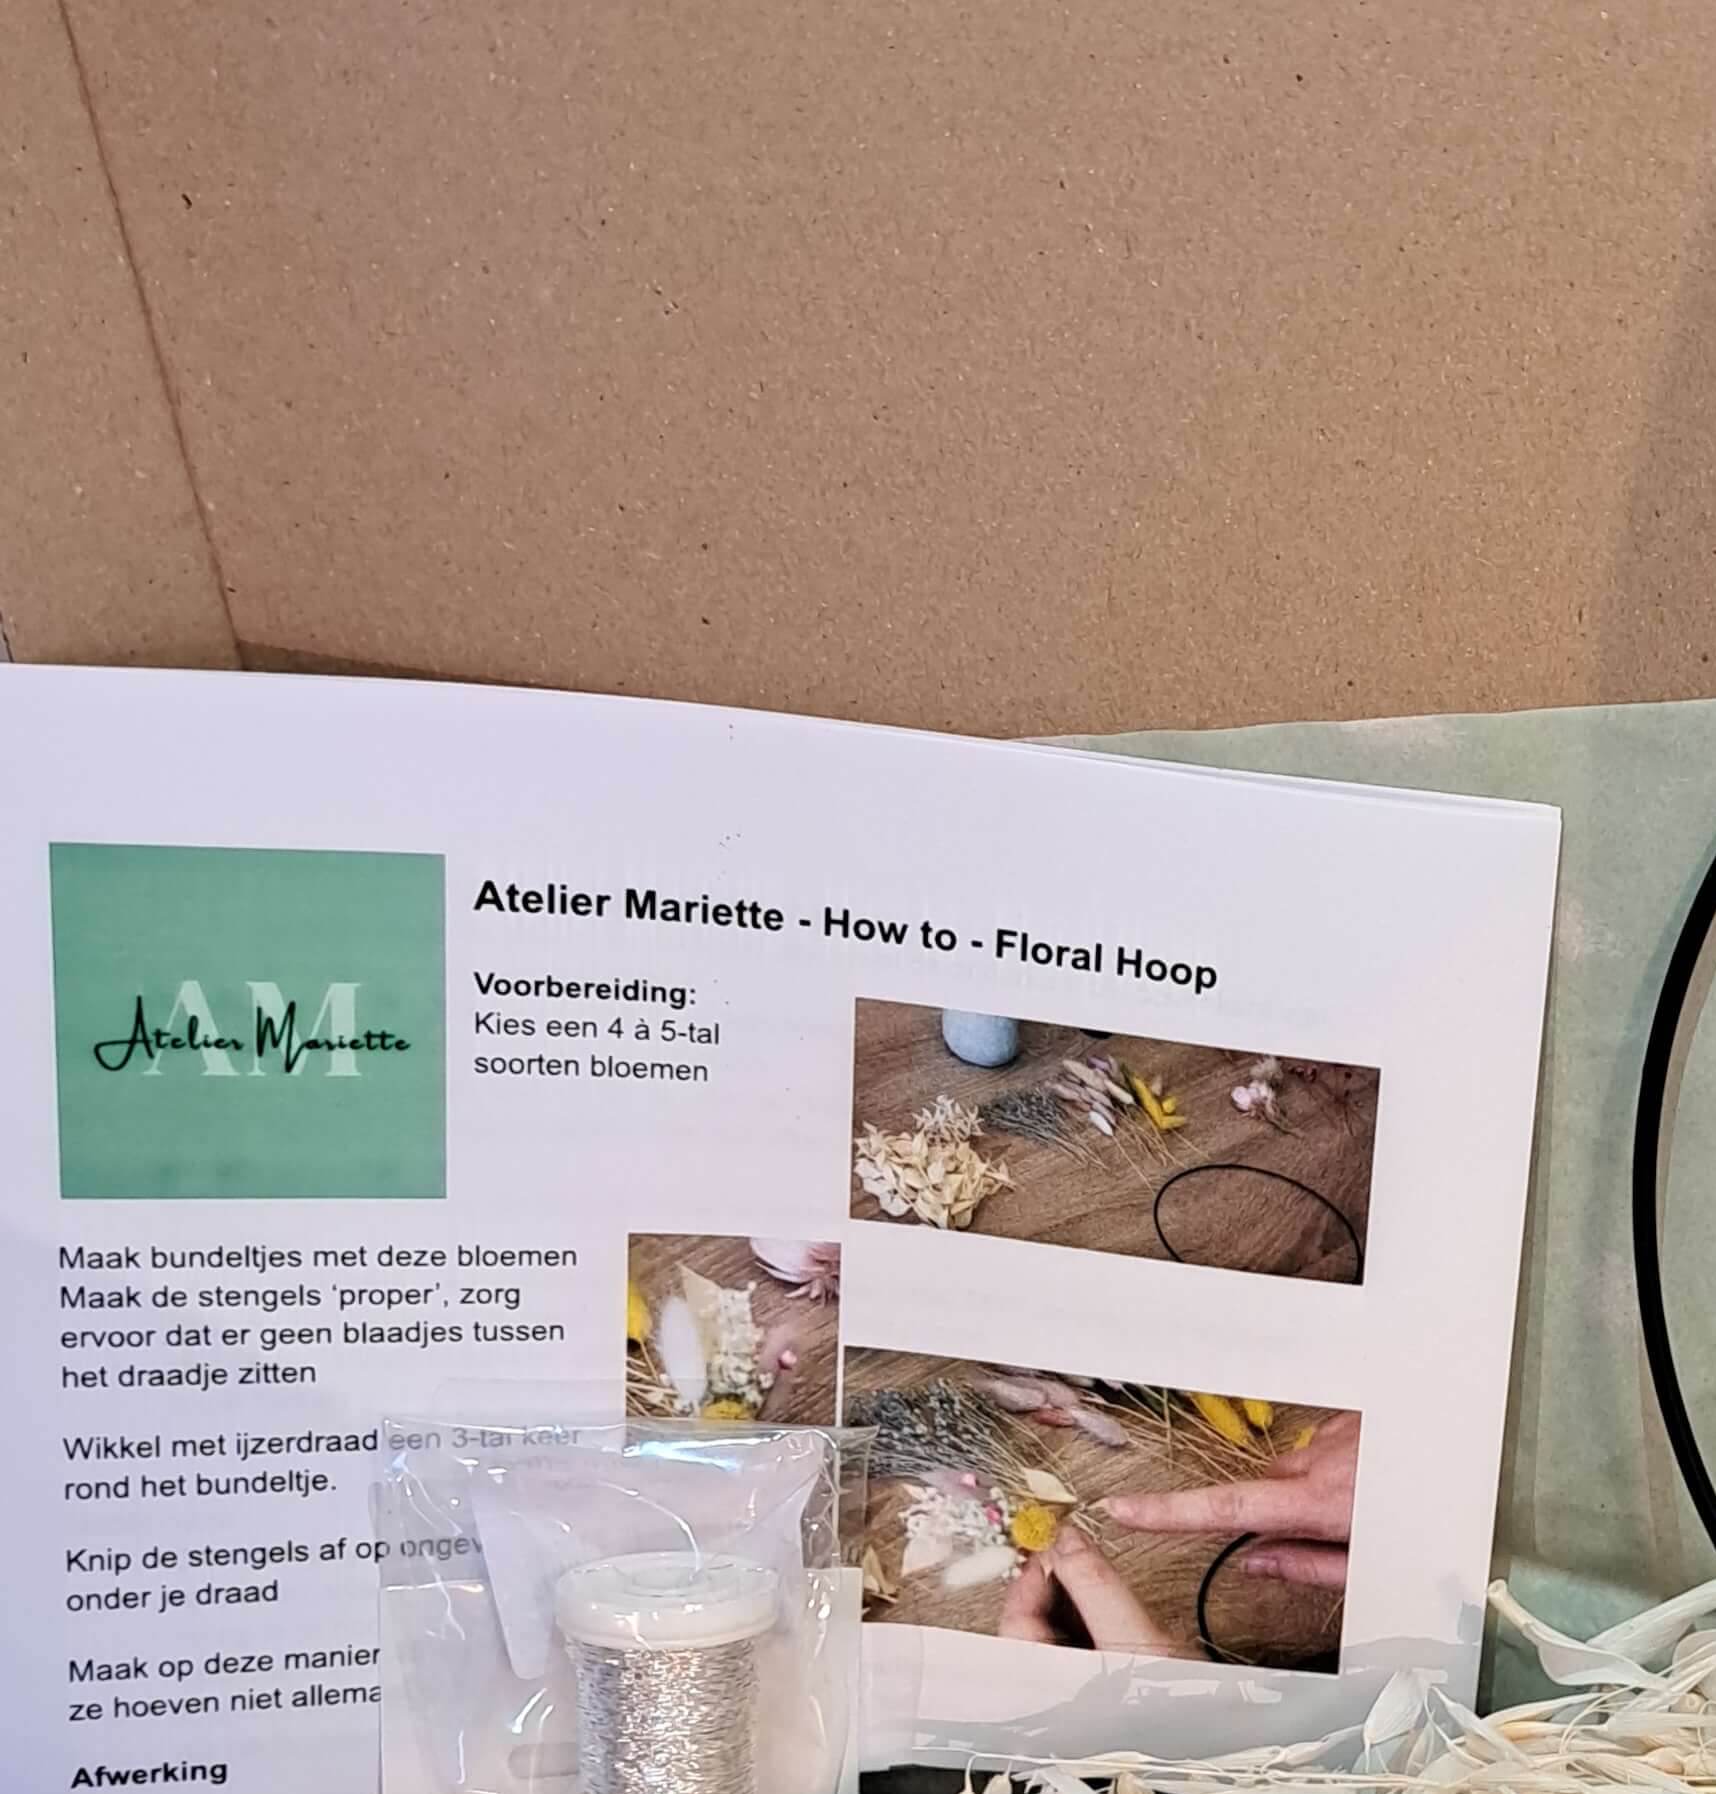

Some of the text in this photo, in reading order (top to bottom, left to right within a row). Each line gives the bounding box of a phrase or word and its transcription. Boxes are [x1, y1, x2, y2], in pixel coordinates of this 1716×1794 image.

[473, 880, 612, 917] Atelier
[625, 888, 784, 931] Mariette
[824, 906, 909, 945] How
[920, 920, 957, 951] to
[996, 928, 1102, 973] Floral
[1117, 946, 1217, 995] Hoop
[473, 971, 696, 1009] Voorbereiding:
[93, 995, 411, 1073] Atelier Mariette
[142, 979, 362, 1077] AM
[474, 1010, 720, 1046] Kies een 4 à 5-tal
[474, 1053, 709, 1083] soorten bloemen
[59, 1244, 577, 1274] Maak bundeltjes met deze bloemen
[60, 1285, 142, 1310] Maak
[152, 1284, 188, 1309] de
[198, 1283, 321, 1312] stengels
[459, 1287, 520, 1311] zorg
[61, 1320, 565, 1352] ervoor dat er geen blaadjes tussen
[62, 1362, 317, 1392] het draadje zitten
[62, 1434, 160, 1461] Wikkel
[172, 1433, 227, 1458] met
[236, 1427, 378, 1461] ijzerdraad
[388, 1431, 441, 1450] een
[522, 1427, 582, 1446] keer
[65, 1469, 337, 1501] rond het bundeltje.
[66, 1548, 132, 1577] Knip
[142, 1545, 178, 1570] de
[188, 1539, 310, 1571] stengels
[319, 1536, 347, 1562] af
[355, 1540, 391, 1565] op
[66, 1578, 279, 1614] onder je draad
[69, 1644, 380, 1684] Maak op deze manier
[69, 1702, 103, 1723] ze
[114, 1695, 219, 1719] hoeven
[231, 1687, 283, 1712] niet
[70, 1760, 228, 1789] Afwerking
